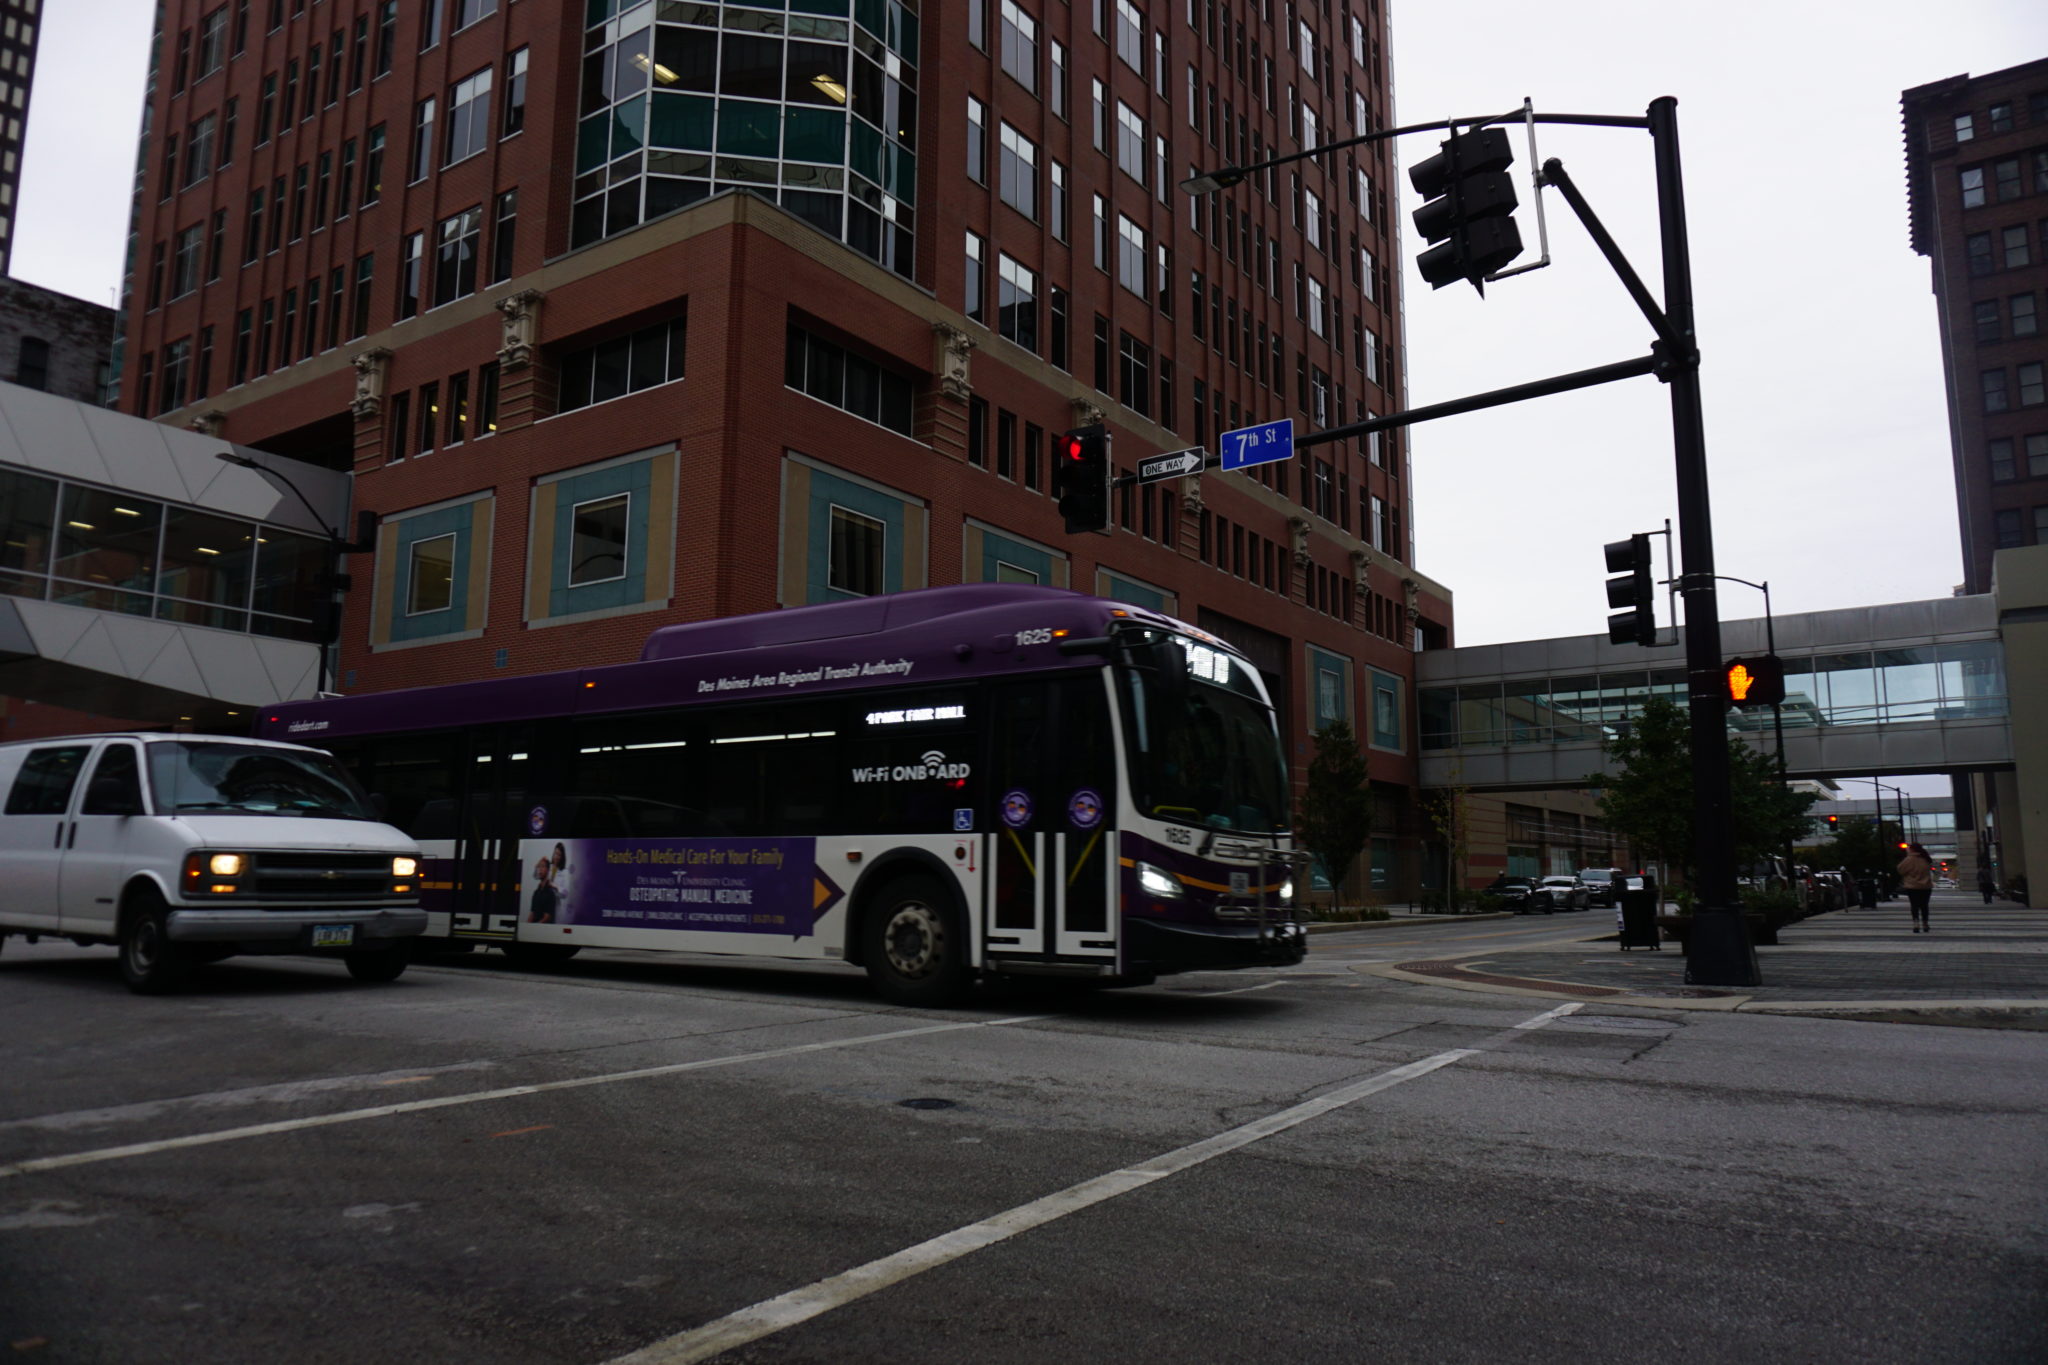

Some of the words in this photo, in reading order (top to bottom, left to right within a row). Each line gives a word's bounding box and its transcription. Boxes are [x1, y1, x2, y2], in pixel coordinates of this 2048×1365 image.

[1236, 432, 1259, 462] 7th
[1265, 428, 1277, 444] St
[1145, 464, 1163, 475] ONE
[1166, 458, 1185, 470] WAY
[1014, 627, 1053, 646] 1625
[697, 680, 715, 693] Des
[716, 676, 751, 691] Moines
[751, 674, 777, 688] Area
[777, 666, 824, 687] Regional
[824, 663, 861, 680] Transit
[860, 658, 915, 676] Authority
[1165, 828, 1192, 846] 1625
[606, 849, 648, 864] Hands-On
[651, 848, 686, 865] Medical
[687, 849, 708, 865] Care
[710, 849, 726, 864] For
[728, 849, 750, 865] Your
[752, 848, 784, 870] Family
[629, 887, 679, 902] OSTEOPATHIC
[681, 888, 712, 904] MANUAL
[714, 889, 753, 905] MEDICINE
